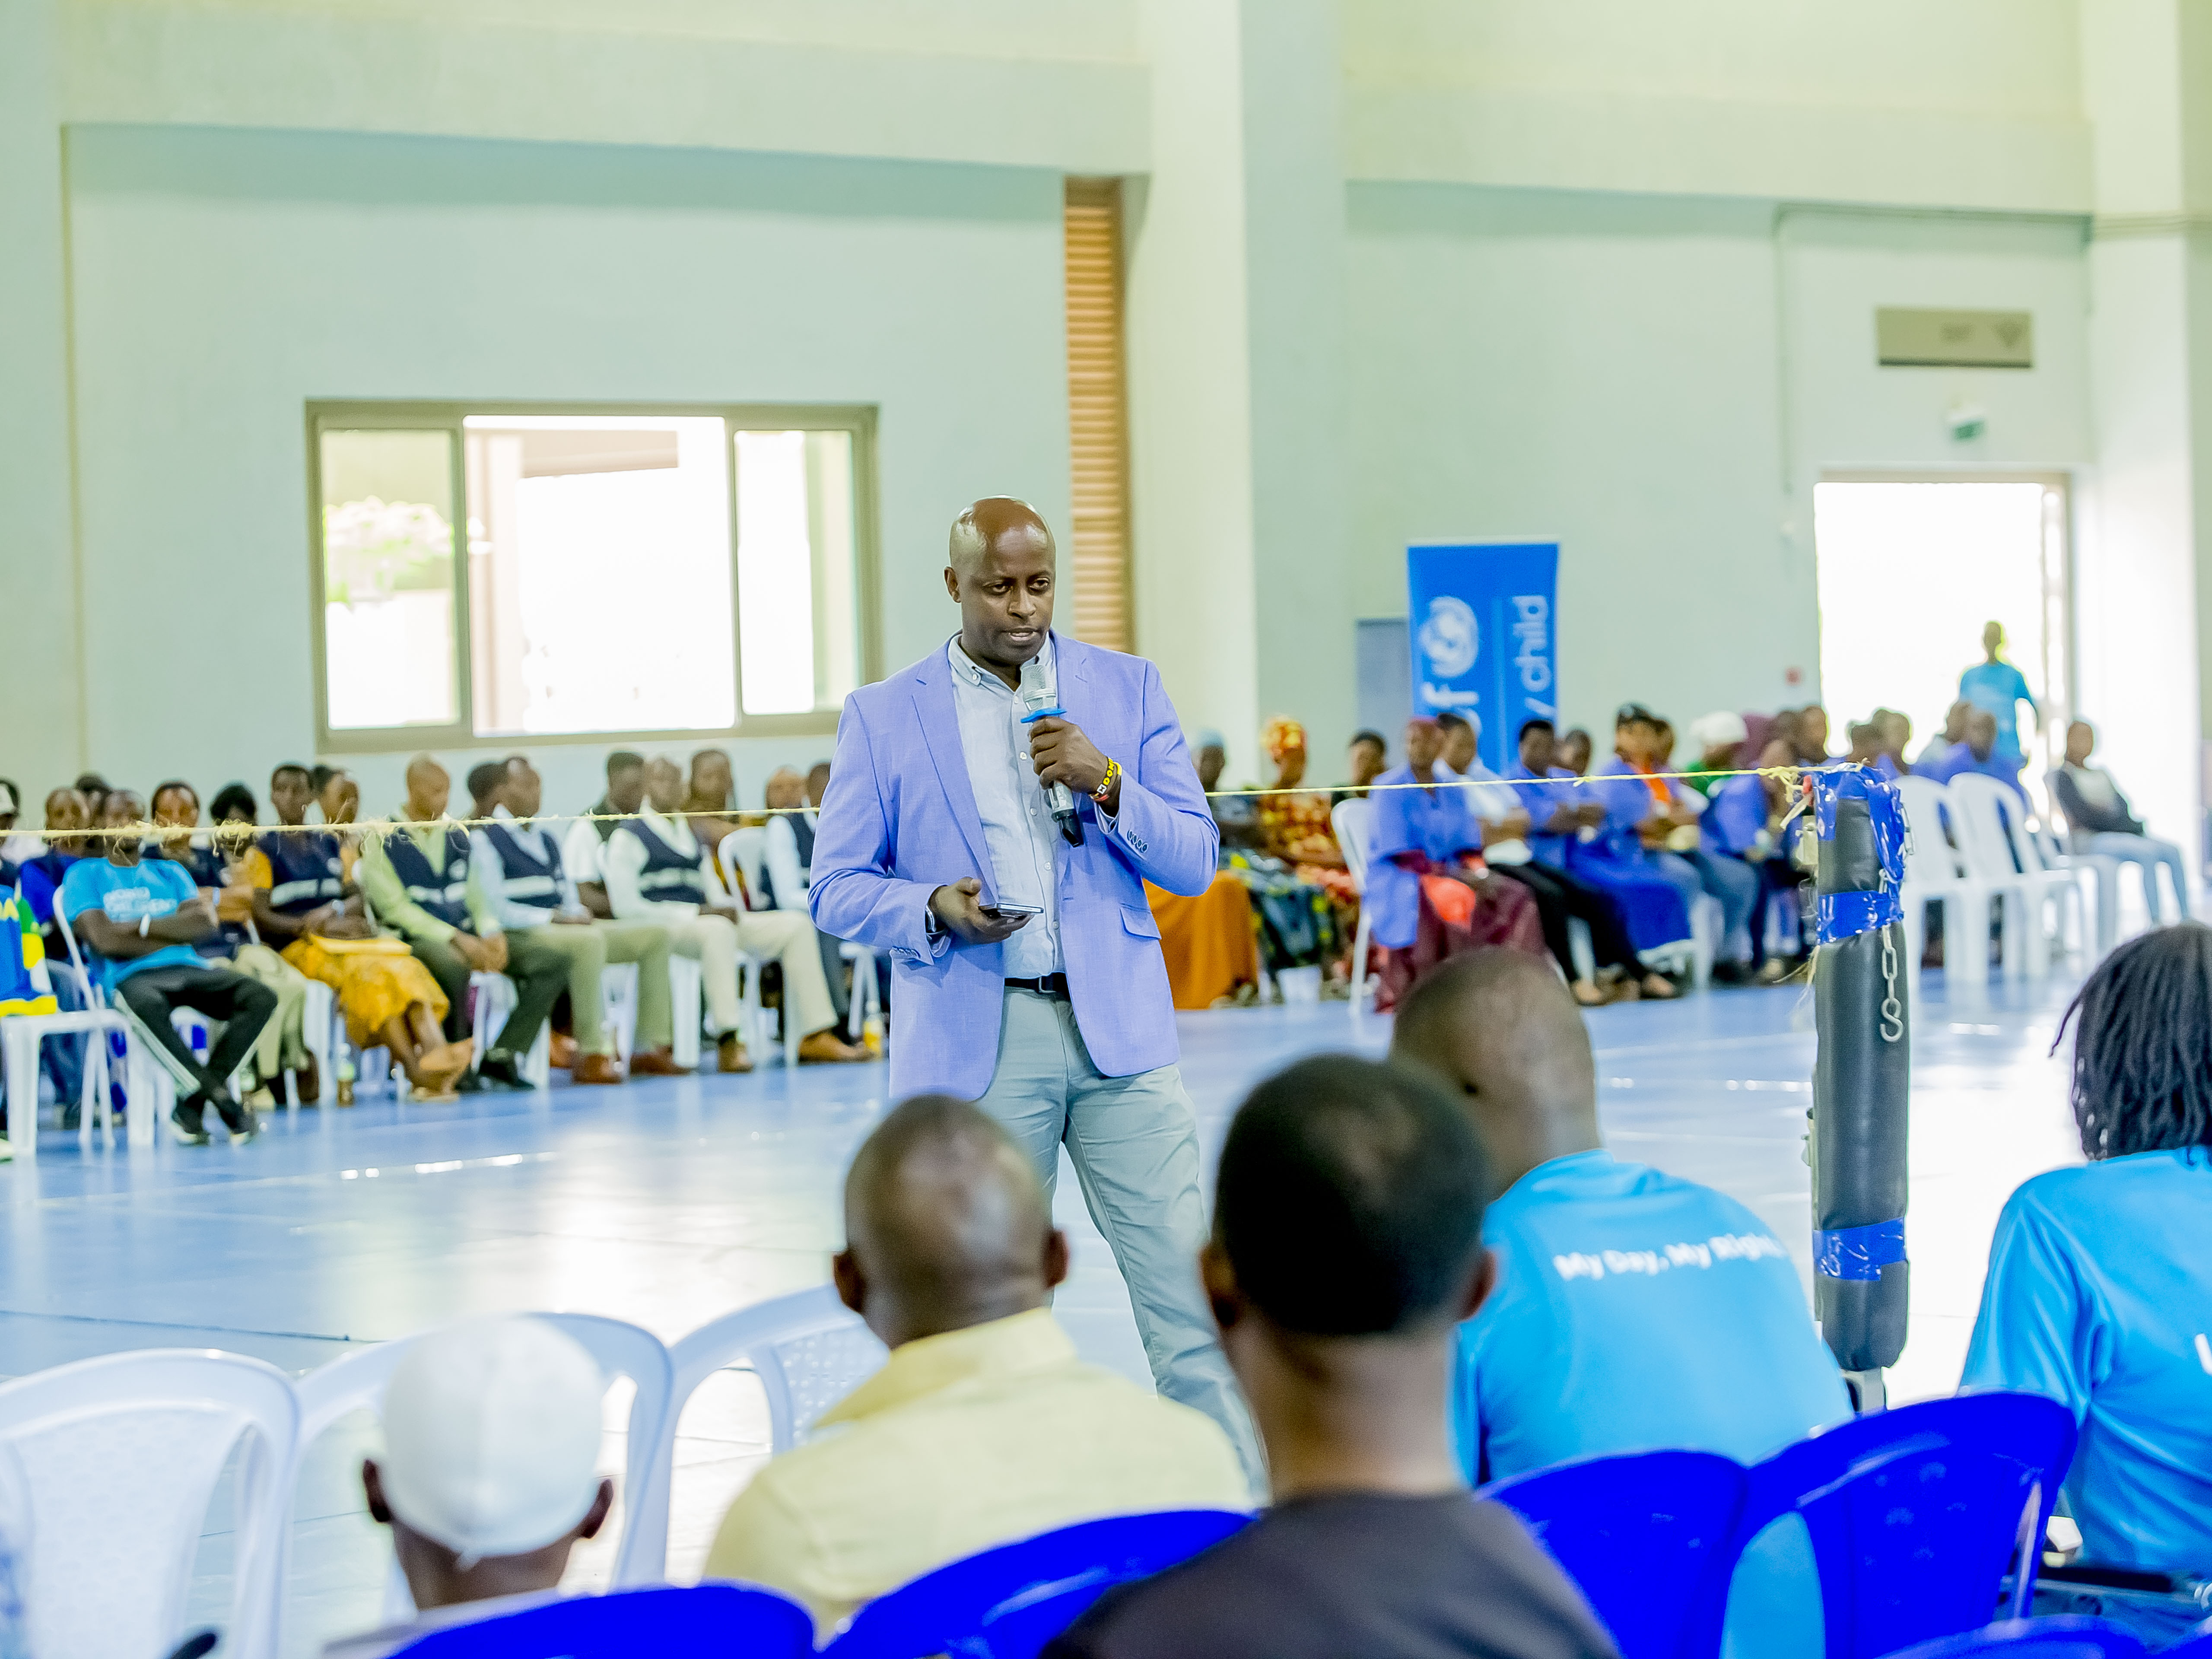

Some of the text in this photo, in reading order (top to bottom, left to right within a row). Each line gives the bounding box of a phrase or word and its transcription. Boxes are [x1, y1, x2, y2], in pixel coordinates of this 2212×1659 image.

[1513, 595, 1552, 692] child
[1554, 1252, 1605, 1281] My
[1663, 1241, 1713, 1270] My
